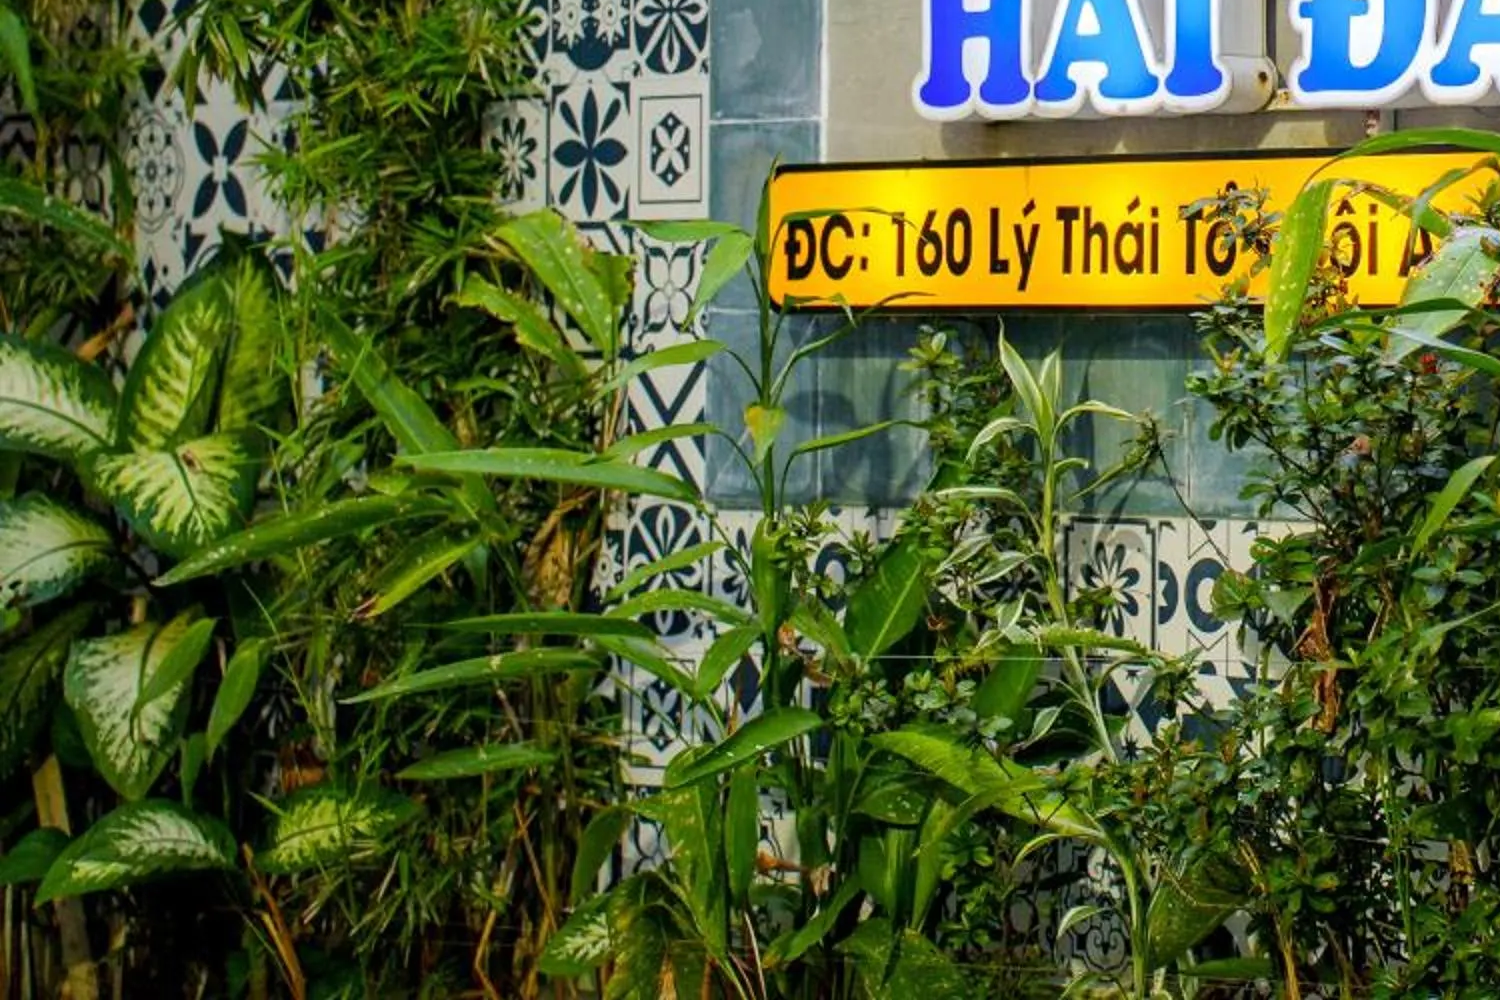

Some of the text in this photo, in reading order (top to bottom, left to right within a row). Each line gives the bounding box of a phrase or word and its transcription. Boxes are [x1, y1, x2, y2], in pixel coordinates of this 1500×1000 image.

[785, 214, 870, 281] ĐC:
[892, 208, 973, 277] 160
[989, 199, 1040, 292] Lý
[1056, 196, 1160, 275] Thái
